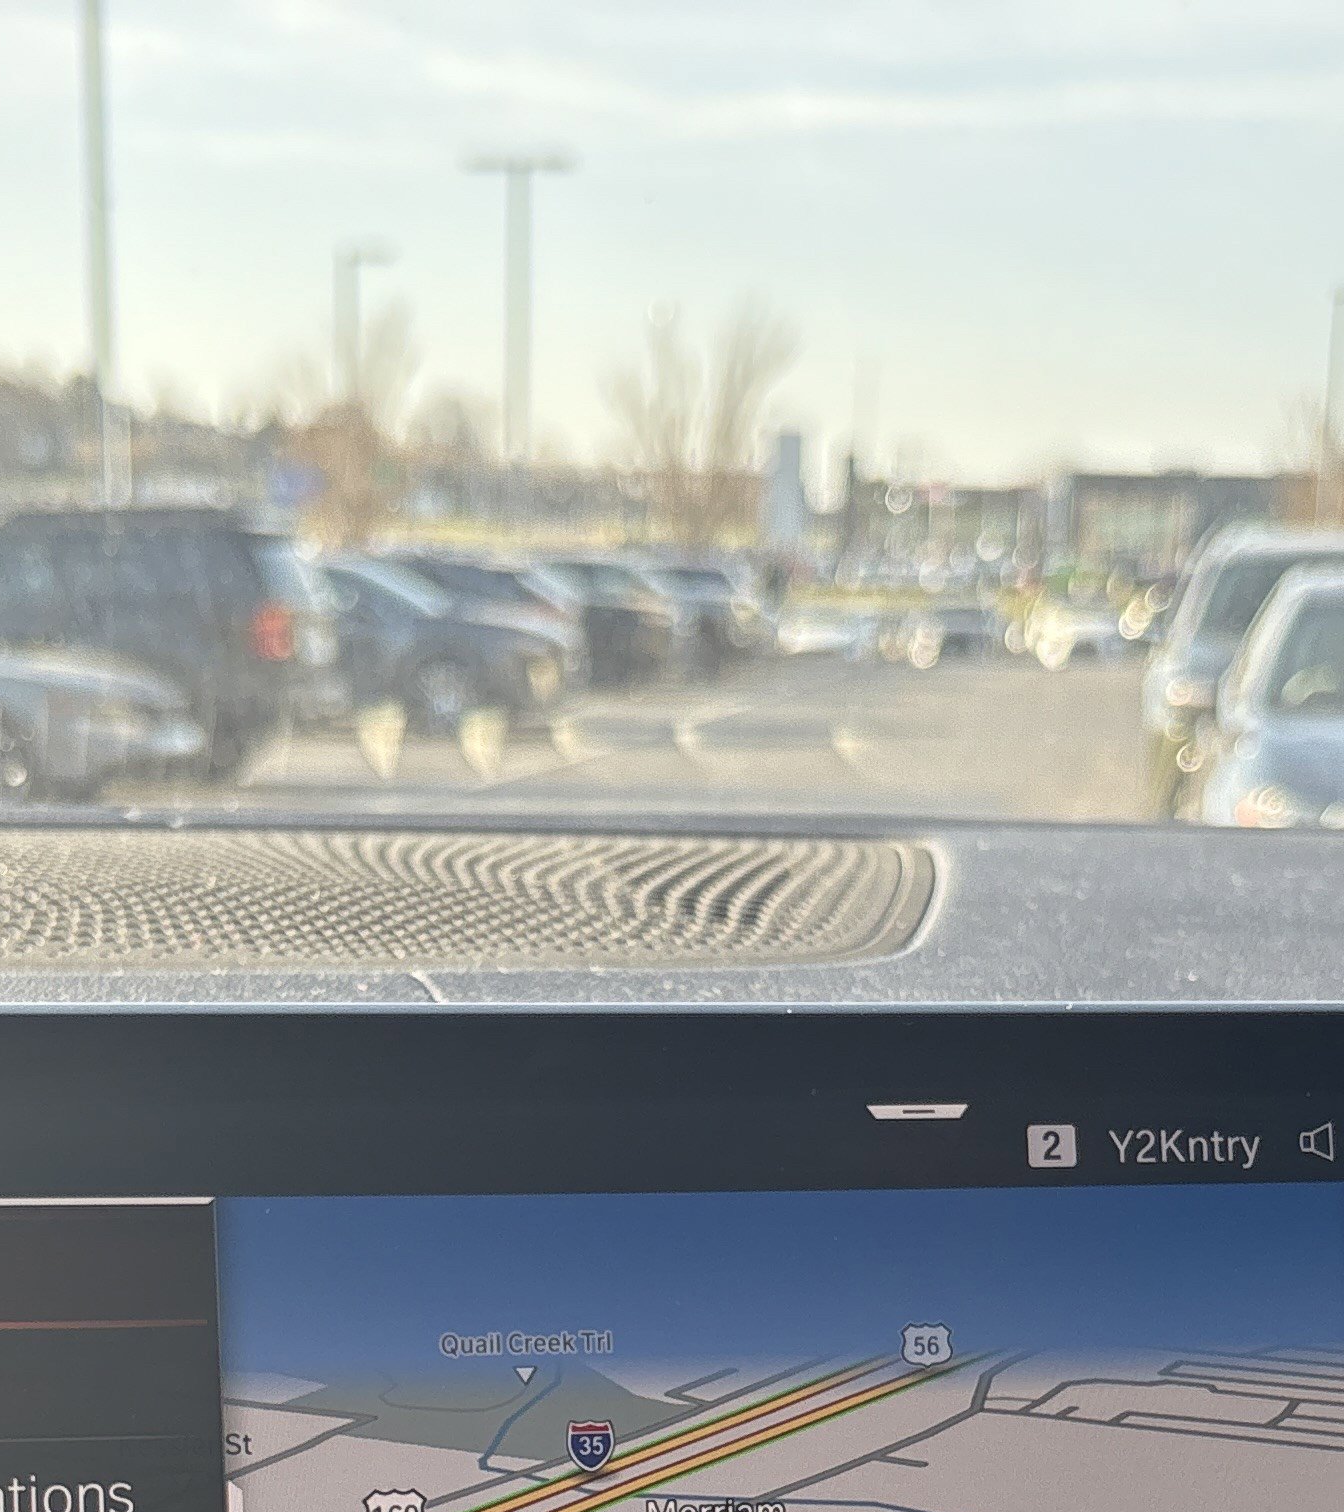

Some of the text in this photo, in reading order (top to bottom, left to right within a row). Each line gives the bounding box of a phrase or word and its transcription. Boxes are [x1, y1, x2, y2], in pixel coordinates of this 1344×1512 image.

[1040, 1132, 1063, 1160] 2
[1108, 1129, 1261, 1169] Y2Kntry
[441, 1331, 613, 1357] Quail Creek Trl
[912, 1336, 940, 1356] 56
[224, 1432, 253, 1456] St
[578, 1435, 605, 1456] 35
